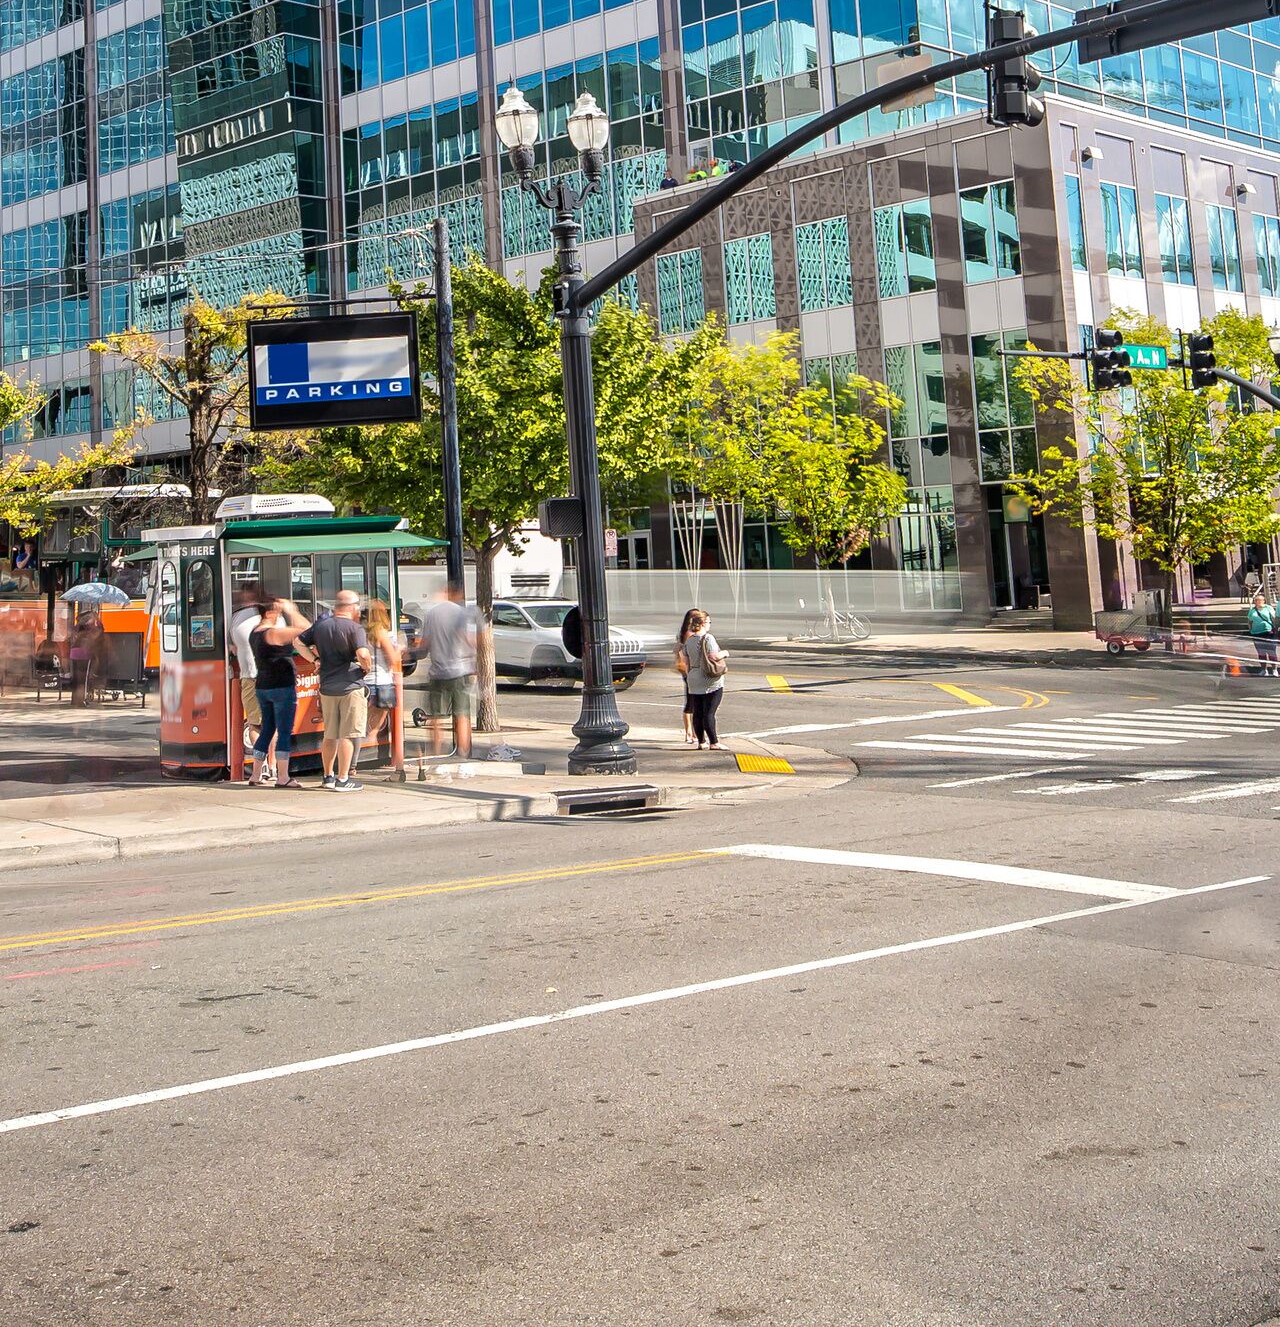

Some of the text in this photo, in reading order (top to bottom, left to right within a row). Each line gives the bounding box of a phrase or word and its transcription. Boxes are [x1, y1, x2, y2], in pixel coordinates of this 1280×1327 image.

[1151, 350, 1160, 366] N
[265, 381, 403, 401] PARKING
[190, 545, 215, 557] HERE
